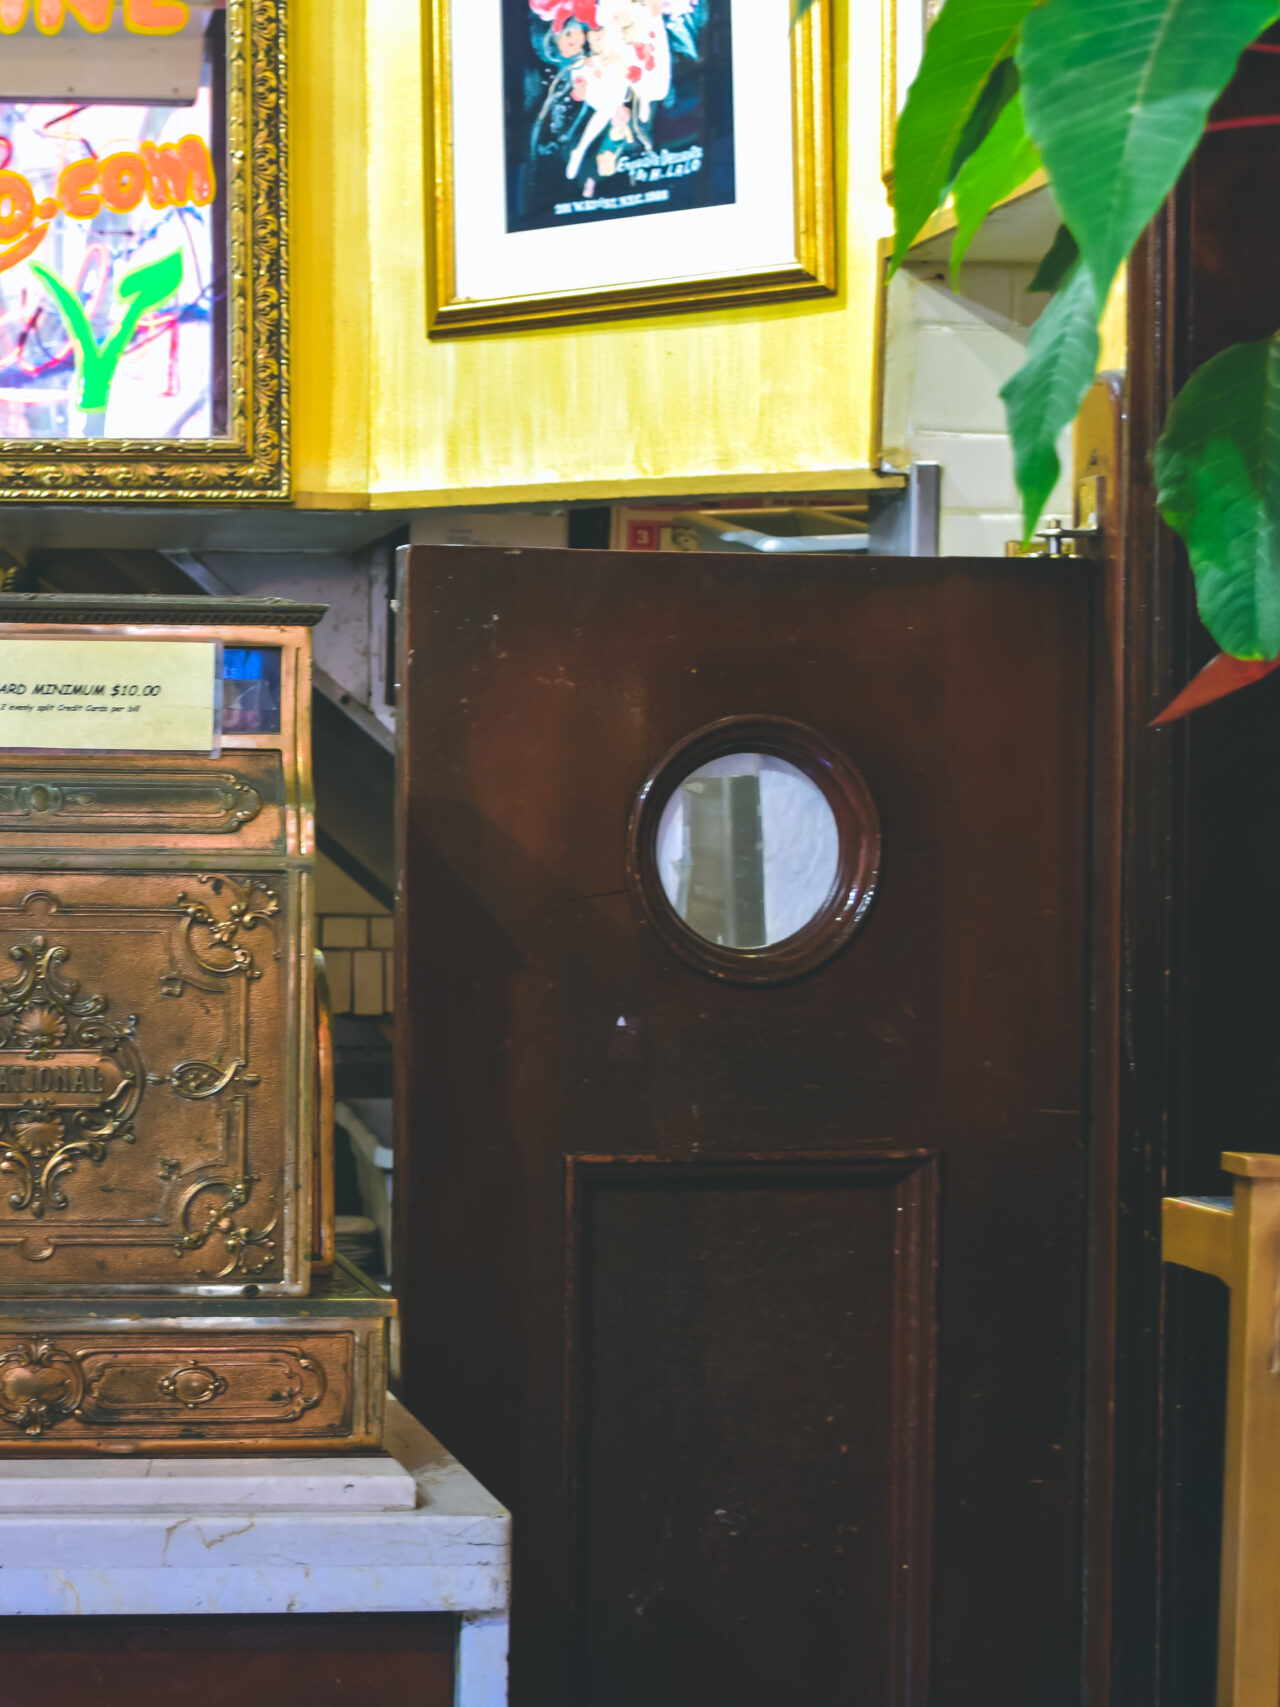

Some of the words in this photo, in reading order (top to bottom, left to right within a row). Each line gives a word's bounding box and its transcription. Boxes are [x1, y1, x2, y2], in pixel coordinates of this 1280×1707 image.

[31, 684, 105, 696] MINIMUM
[110, 684, 161, 697] $10.00
[57, 704, 83, 712] Credit
